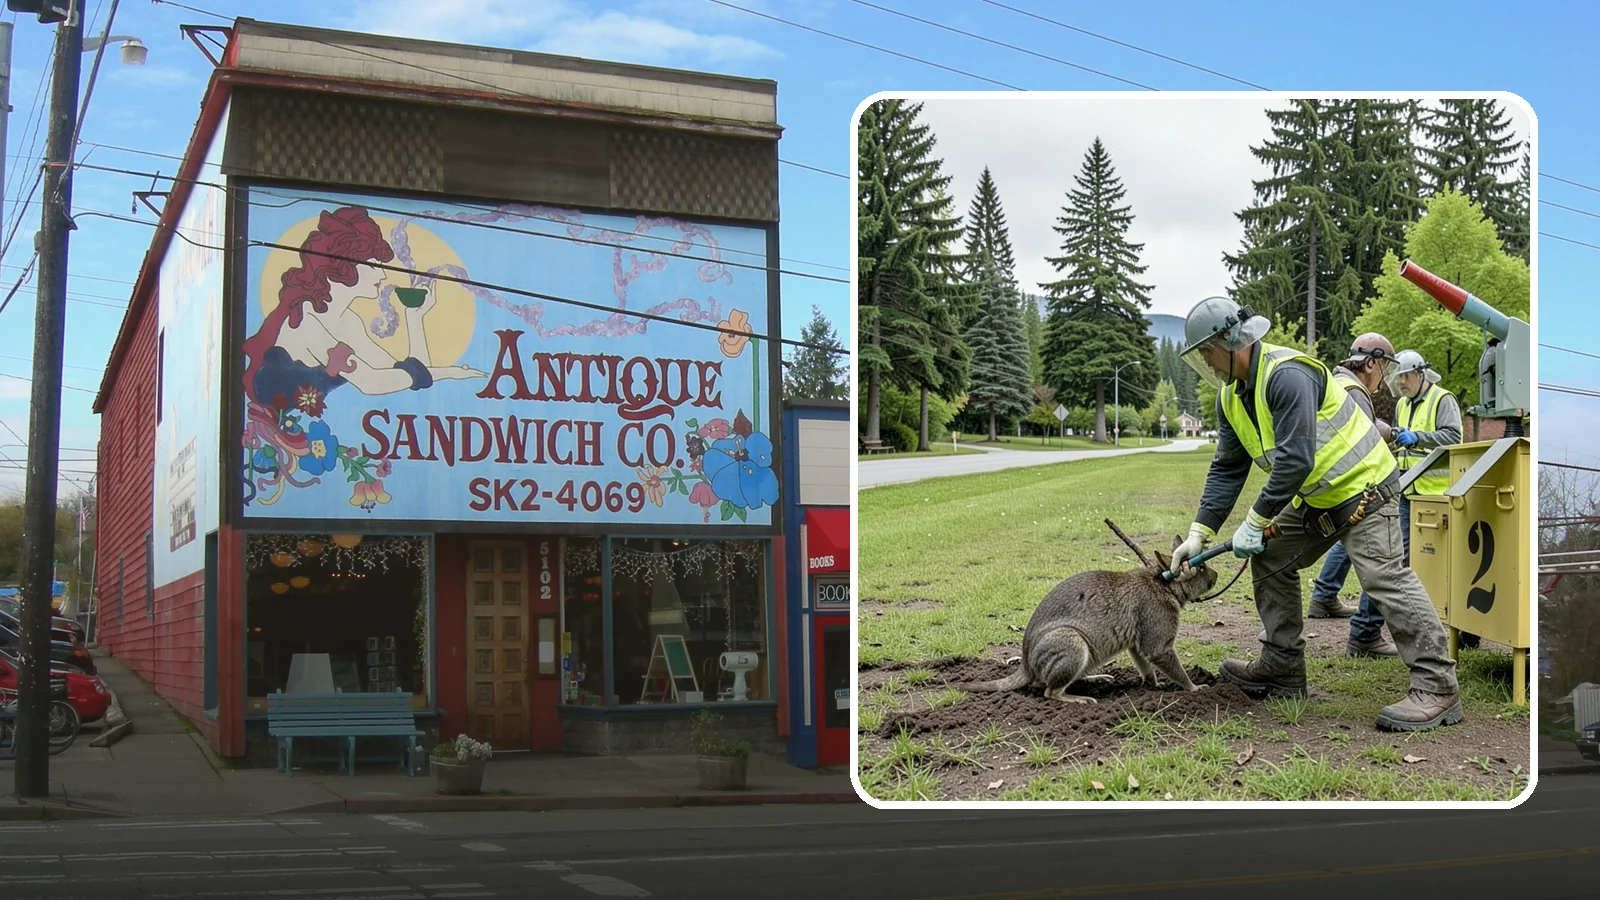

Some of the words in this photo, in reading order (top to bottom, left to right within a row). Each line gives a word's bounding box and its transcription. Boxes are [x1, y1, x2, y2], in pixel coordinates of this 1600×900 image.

[476, 328, 723, 420] ANTIQUE
[361, 408, 604, 467] SANDWICH
[617, 422, 685, 468] CO.
[468, 477, 645, 512] SK2-4069
[539, 542, 552, 600] 5102
[809, 555, 835, 569] BOOKS
[1466, 520, 1496, 615] 2
